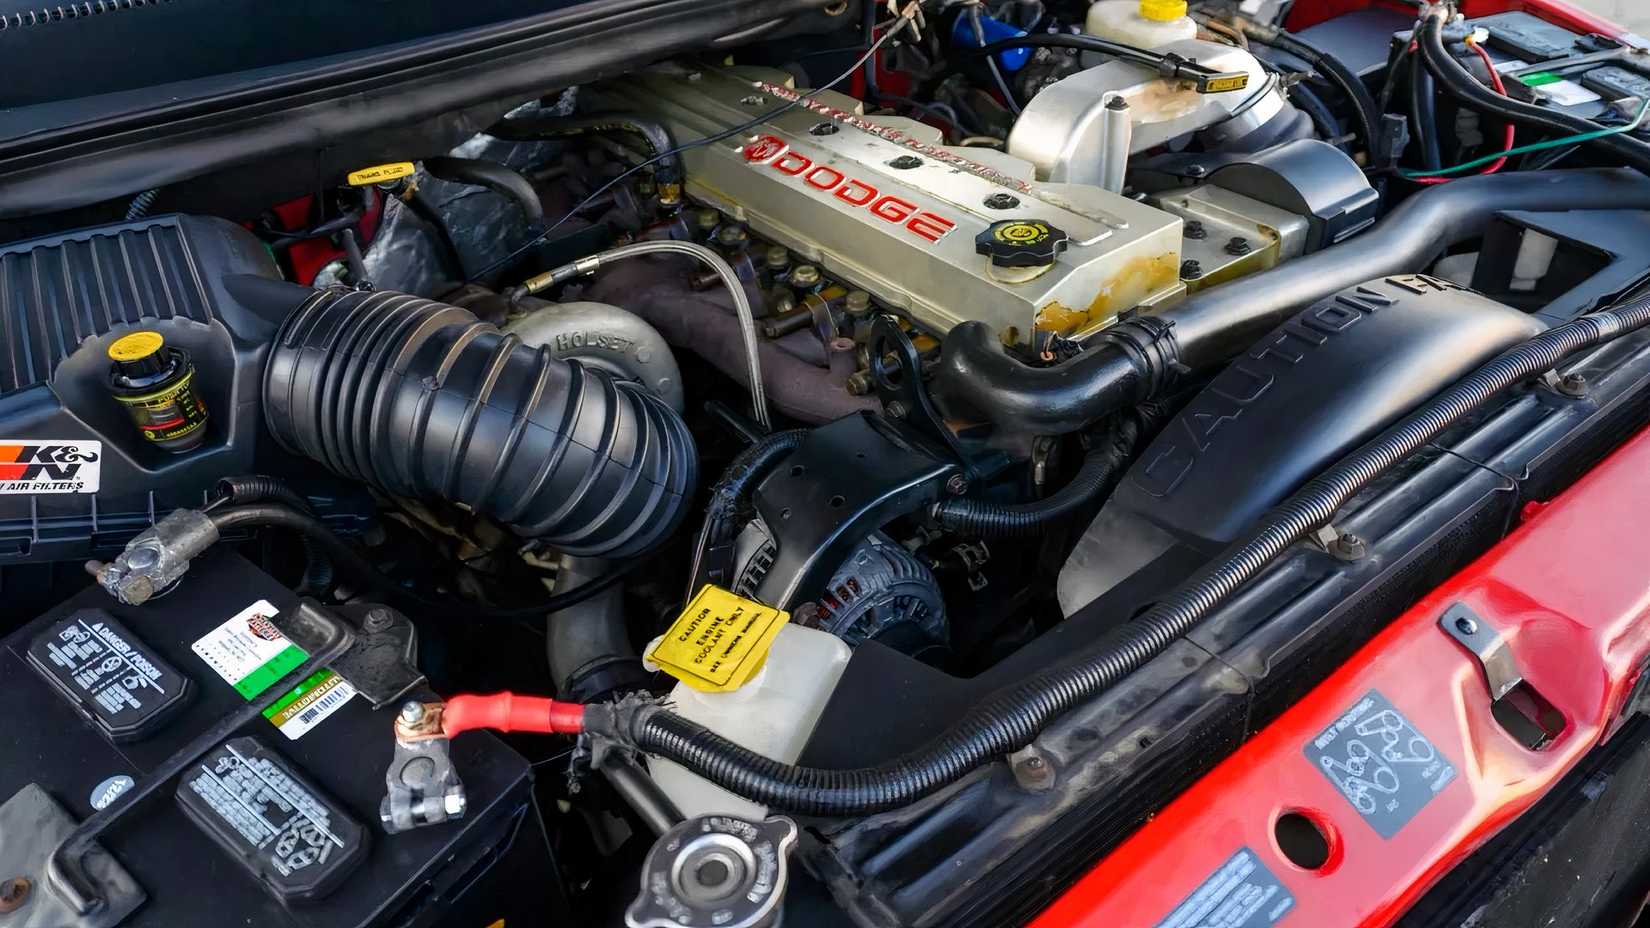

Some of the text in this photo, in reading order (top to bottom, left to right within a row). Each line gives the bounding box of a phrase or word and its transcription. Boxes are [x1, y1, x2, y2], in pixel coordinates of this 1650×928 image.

[771, 150, 957, 243] DODGE
[555, 330, 634, 352] HOLSET
[1135, 286, 1399, 497] CAUTION
[7, 482, 30, 490] AIR
[32, 482, 84, 490] FILTERS
[678, 607, 711, 642] CAUTION
